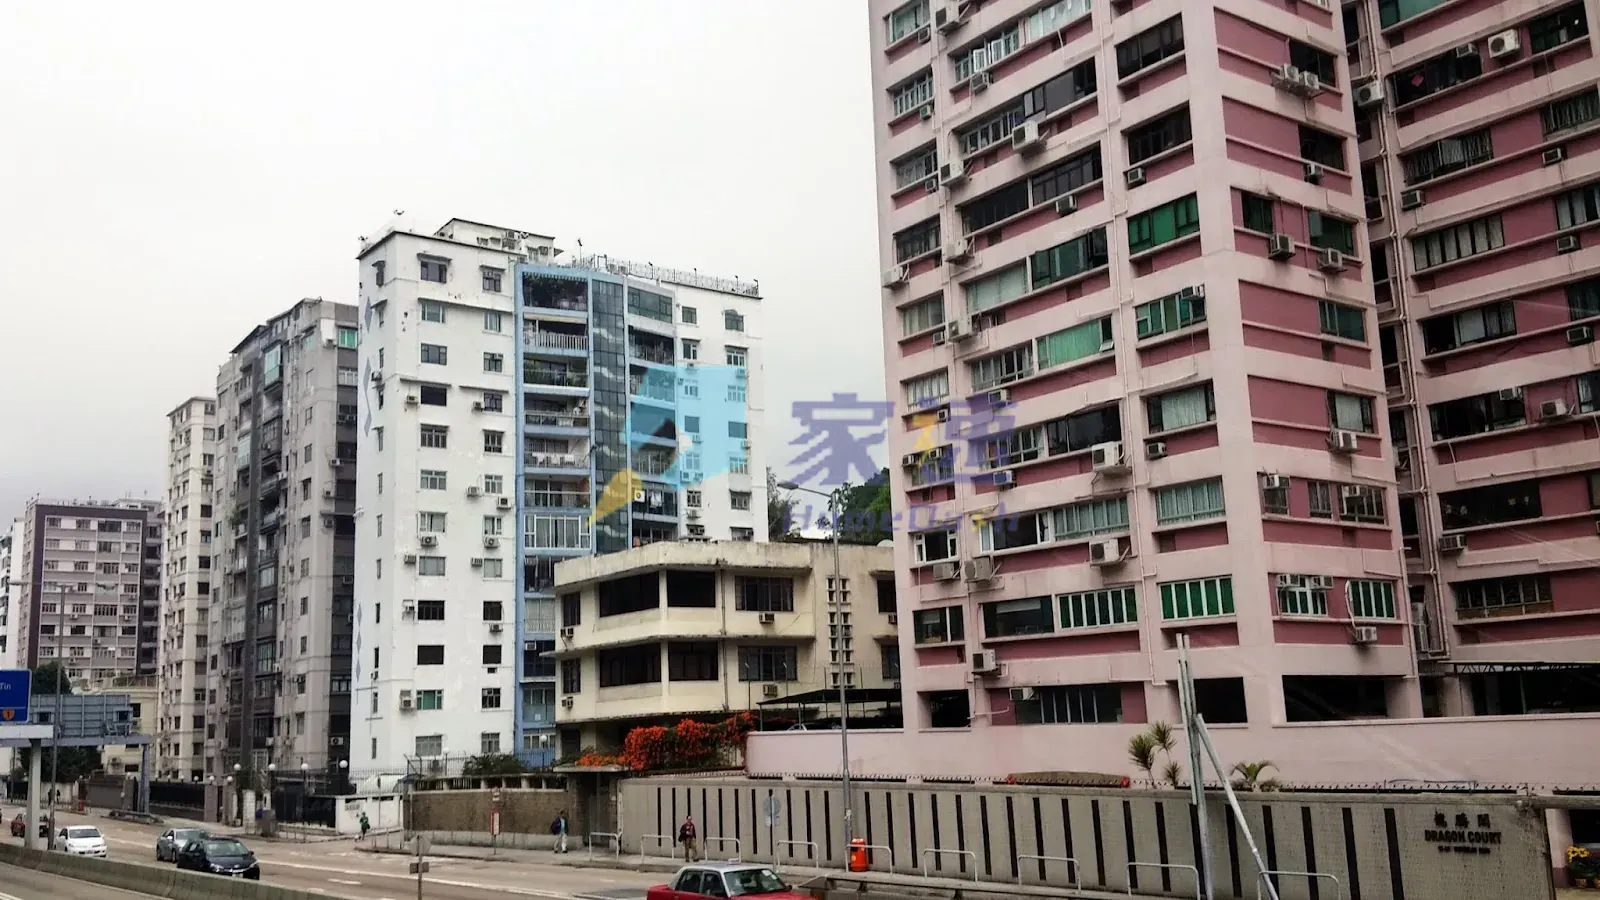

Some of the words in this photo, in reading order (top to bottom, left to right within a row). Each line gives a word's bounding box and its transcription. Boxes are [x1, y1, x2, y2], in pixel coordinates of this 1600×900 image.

[0, 682, 12, 690] Tin
[1424, 829, 1466, 843] DRAGON
[1467, 831, 1502, 845] COURT
